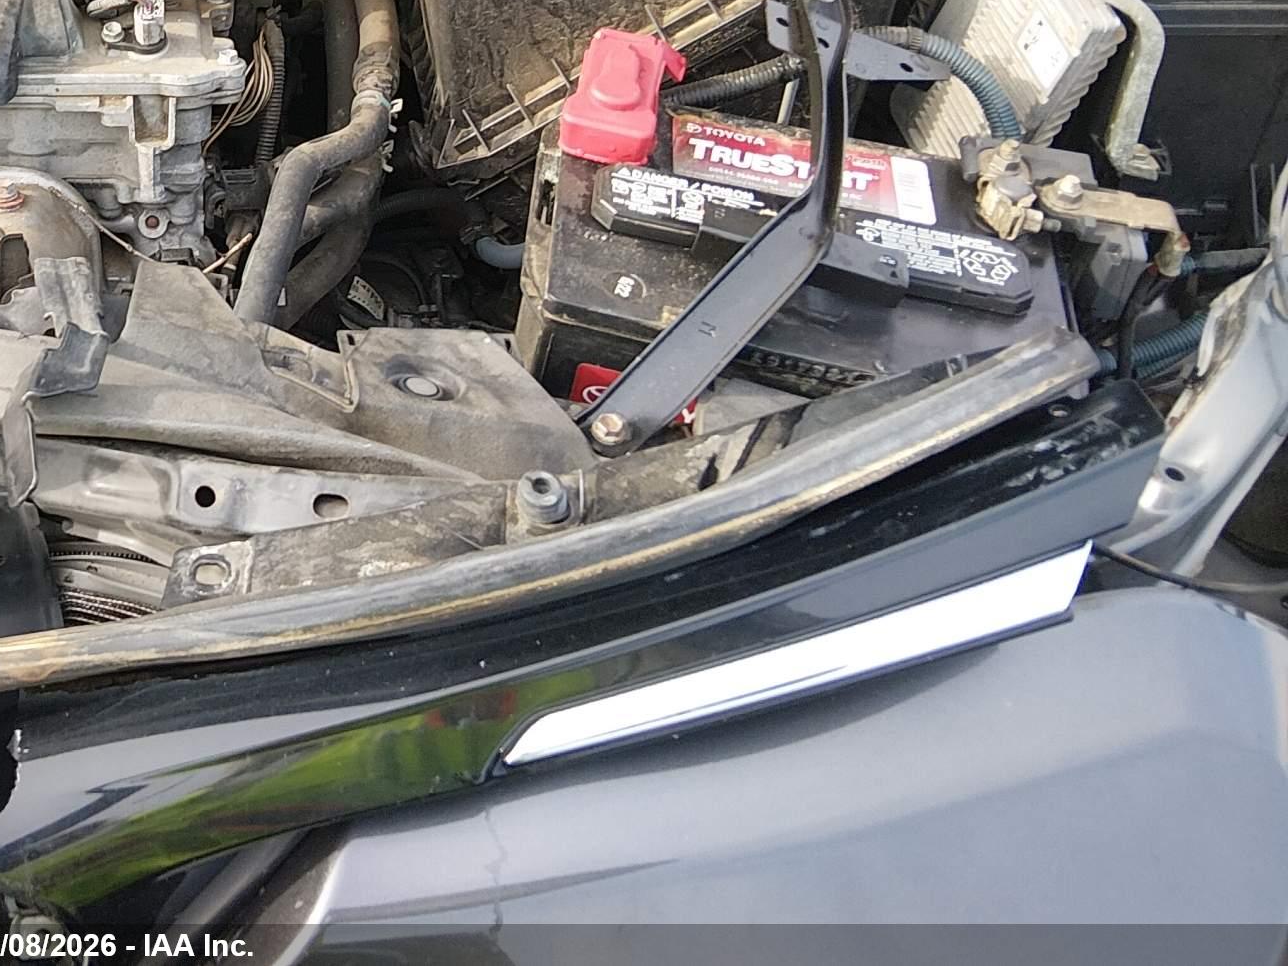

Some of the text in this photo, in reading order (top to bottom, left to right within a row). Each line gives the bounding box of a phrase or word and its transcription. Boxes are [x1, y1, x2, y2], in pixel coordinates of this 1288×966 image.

[705, 126, 766, 147] TOYOTA
[632, 169, 689, 189] DANGER
[701, 182, 755, 202] POISON
